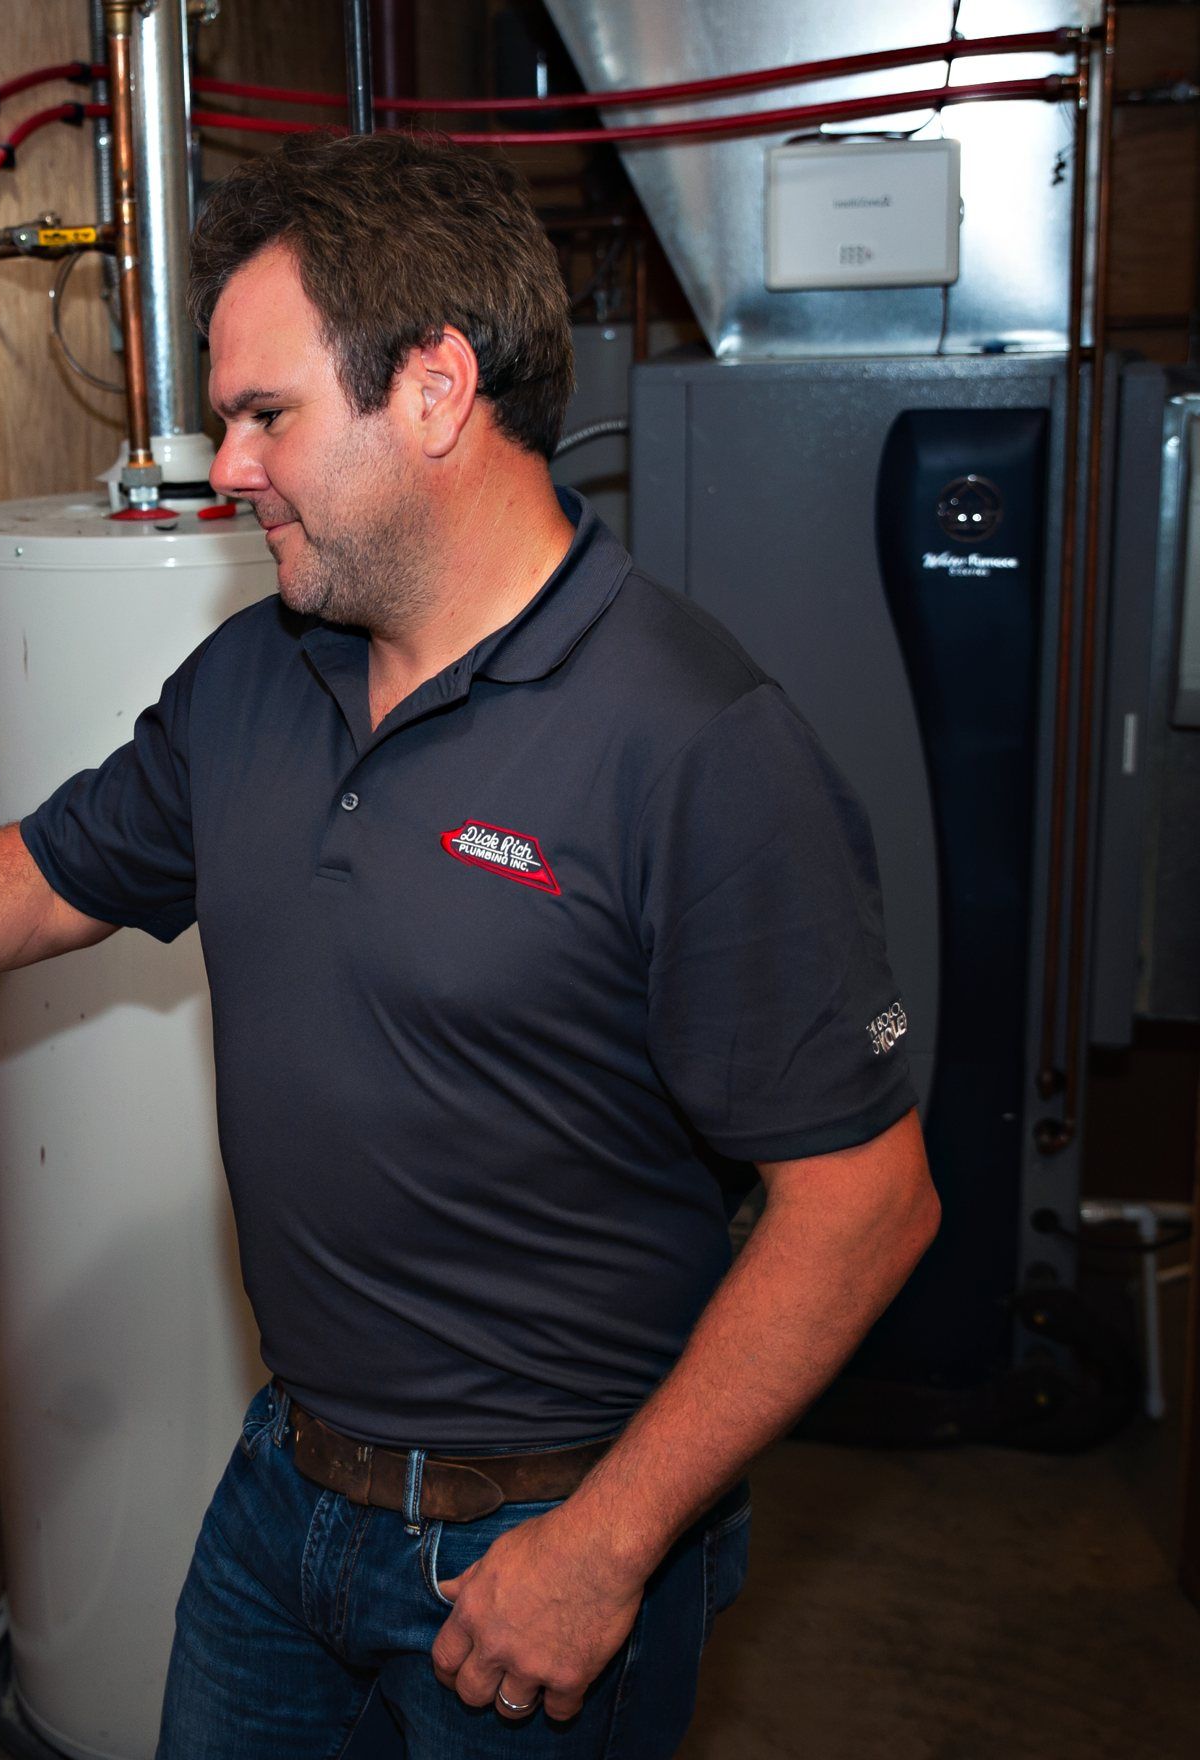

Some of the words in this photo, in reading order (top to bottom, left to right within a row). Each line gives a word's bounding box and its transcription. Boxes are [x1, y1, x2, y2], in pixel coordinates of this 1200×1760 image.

[458, 843, 509, 865] PLUMBING
[509, 857, 529, 872] INC.
[460, 825, 500, 850] Dick
[500, 836, 534, 860] Rich
